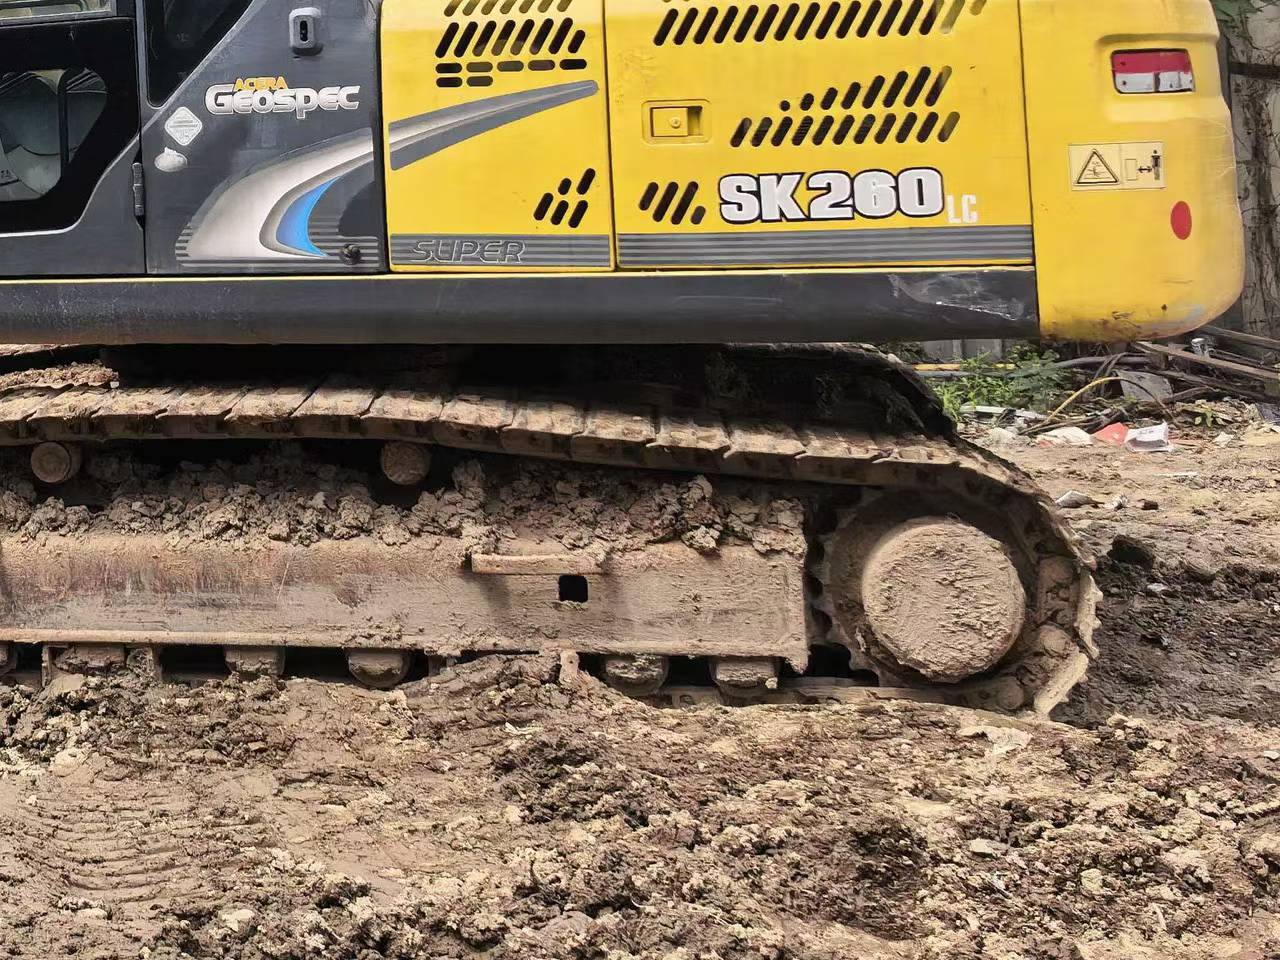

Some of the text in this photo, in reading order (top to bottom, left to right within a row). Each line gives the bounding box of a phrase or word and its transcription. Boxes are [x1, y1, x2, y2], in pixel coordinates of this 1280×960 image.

[718, 166, 978, 224] SK260 LC
[410, 239, 526, 264] SUPER
